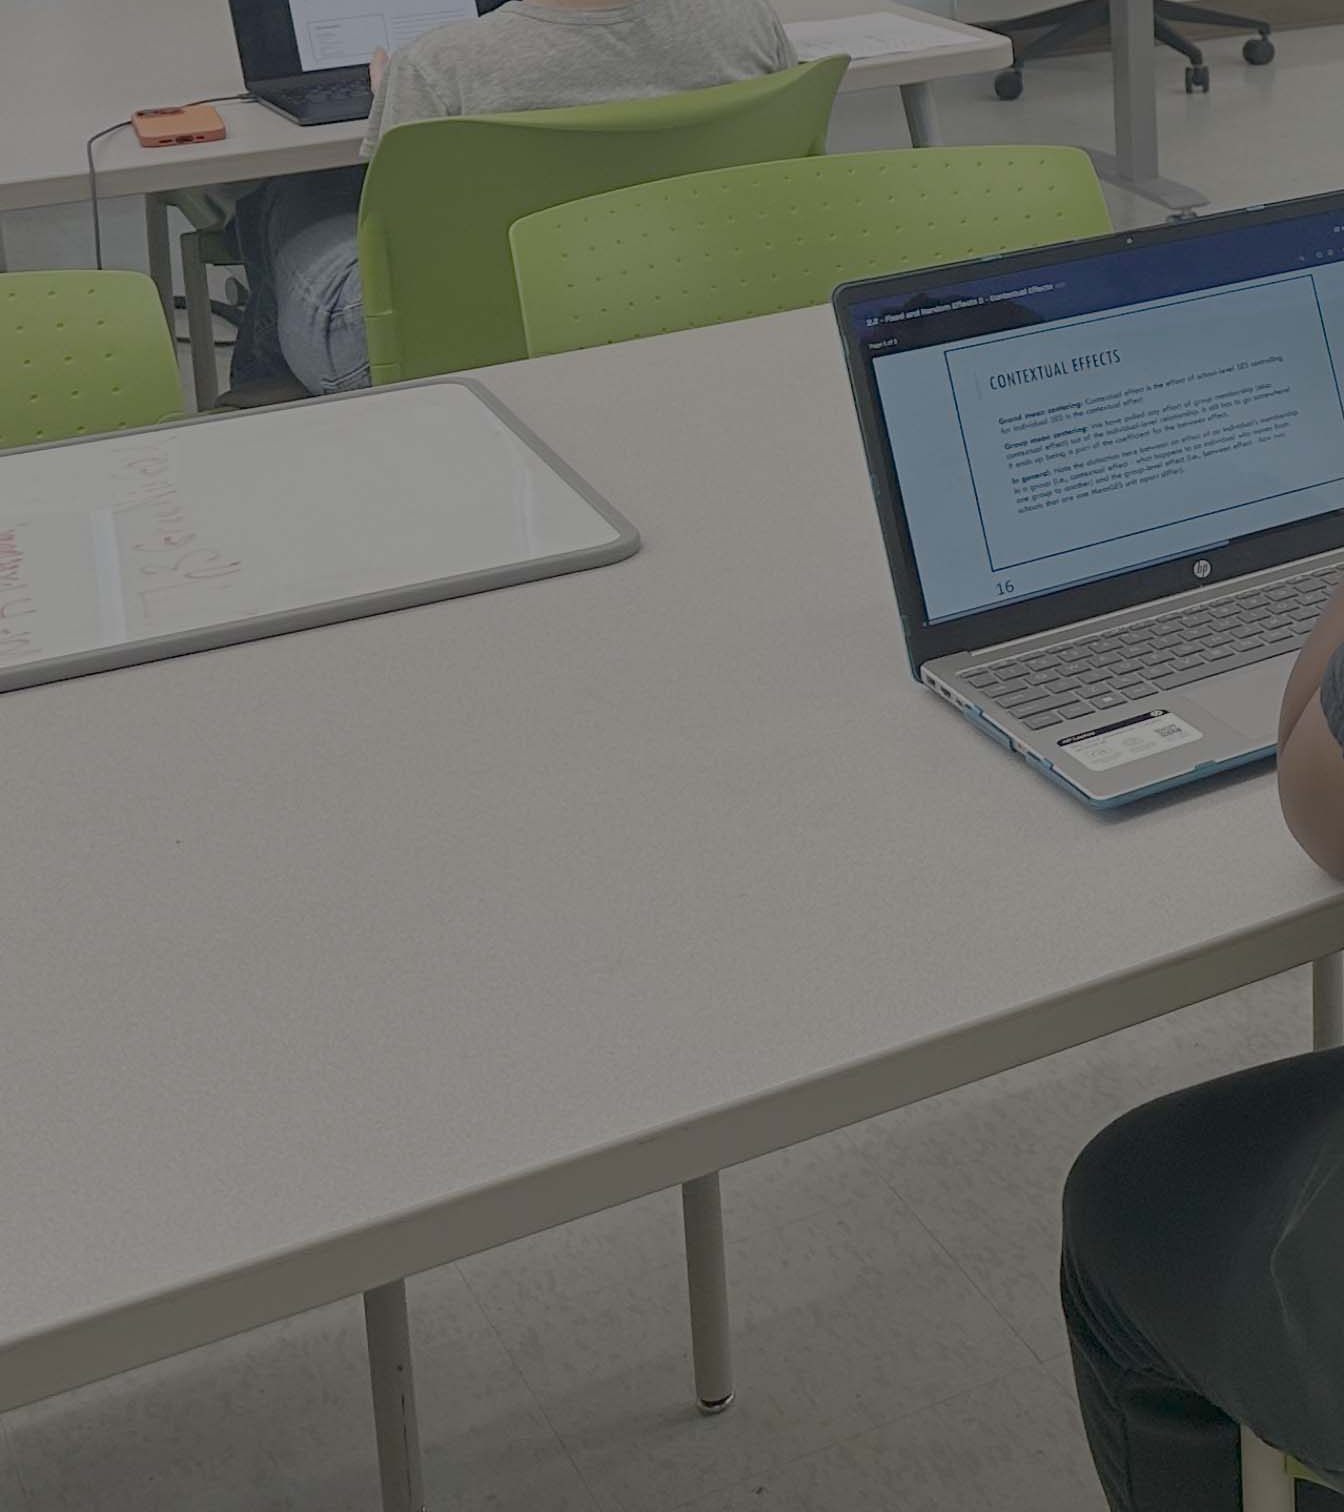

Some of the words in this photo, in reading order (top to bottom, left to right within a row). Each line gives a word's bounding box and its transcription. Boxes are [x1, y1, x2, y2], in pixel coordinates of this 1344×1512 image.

[989, 360, 1069, 391] CONTEXTUAL
[1071, 348, 1121, 372] EFFECTS
[996, 580, 1015, 595] 16
